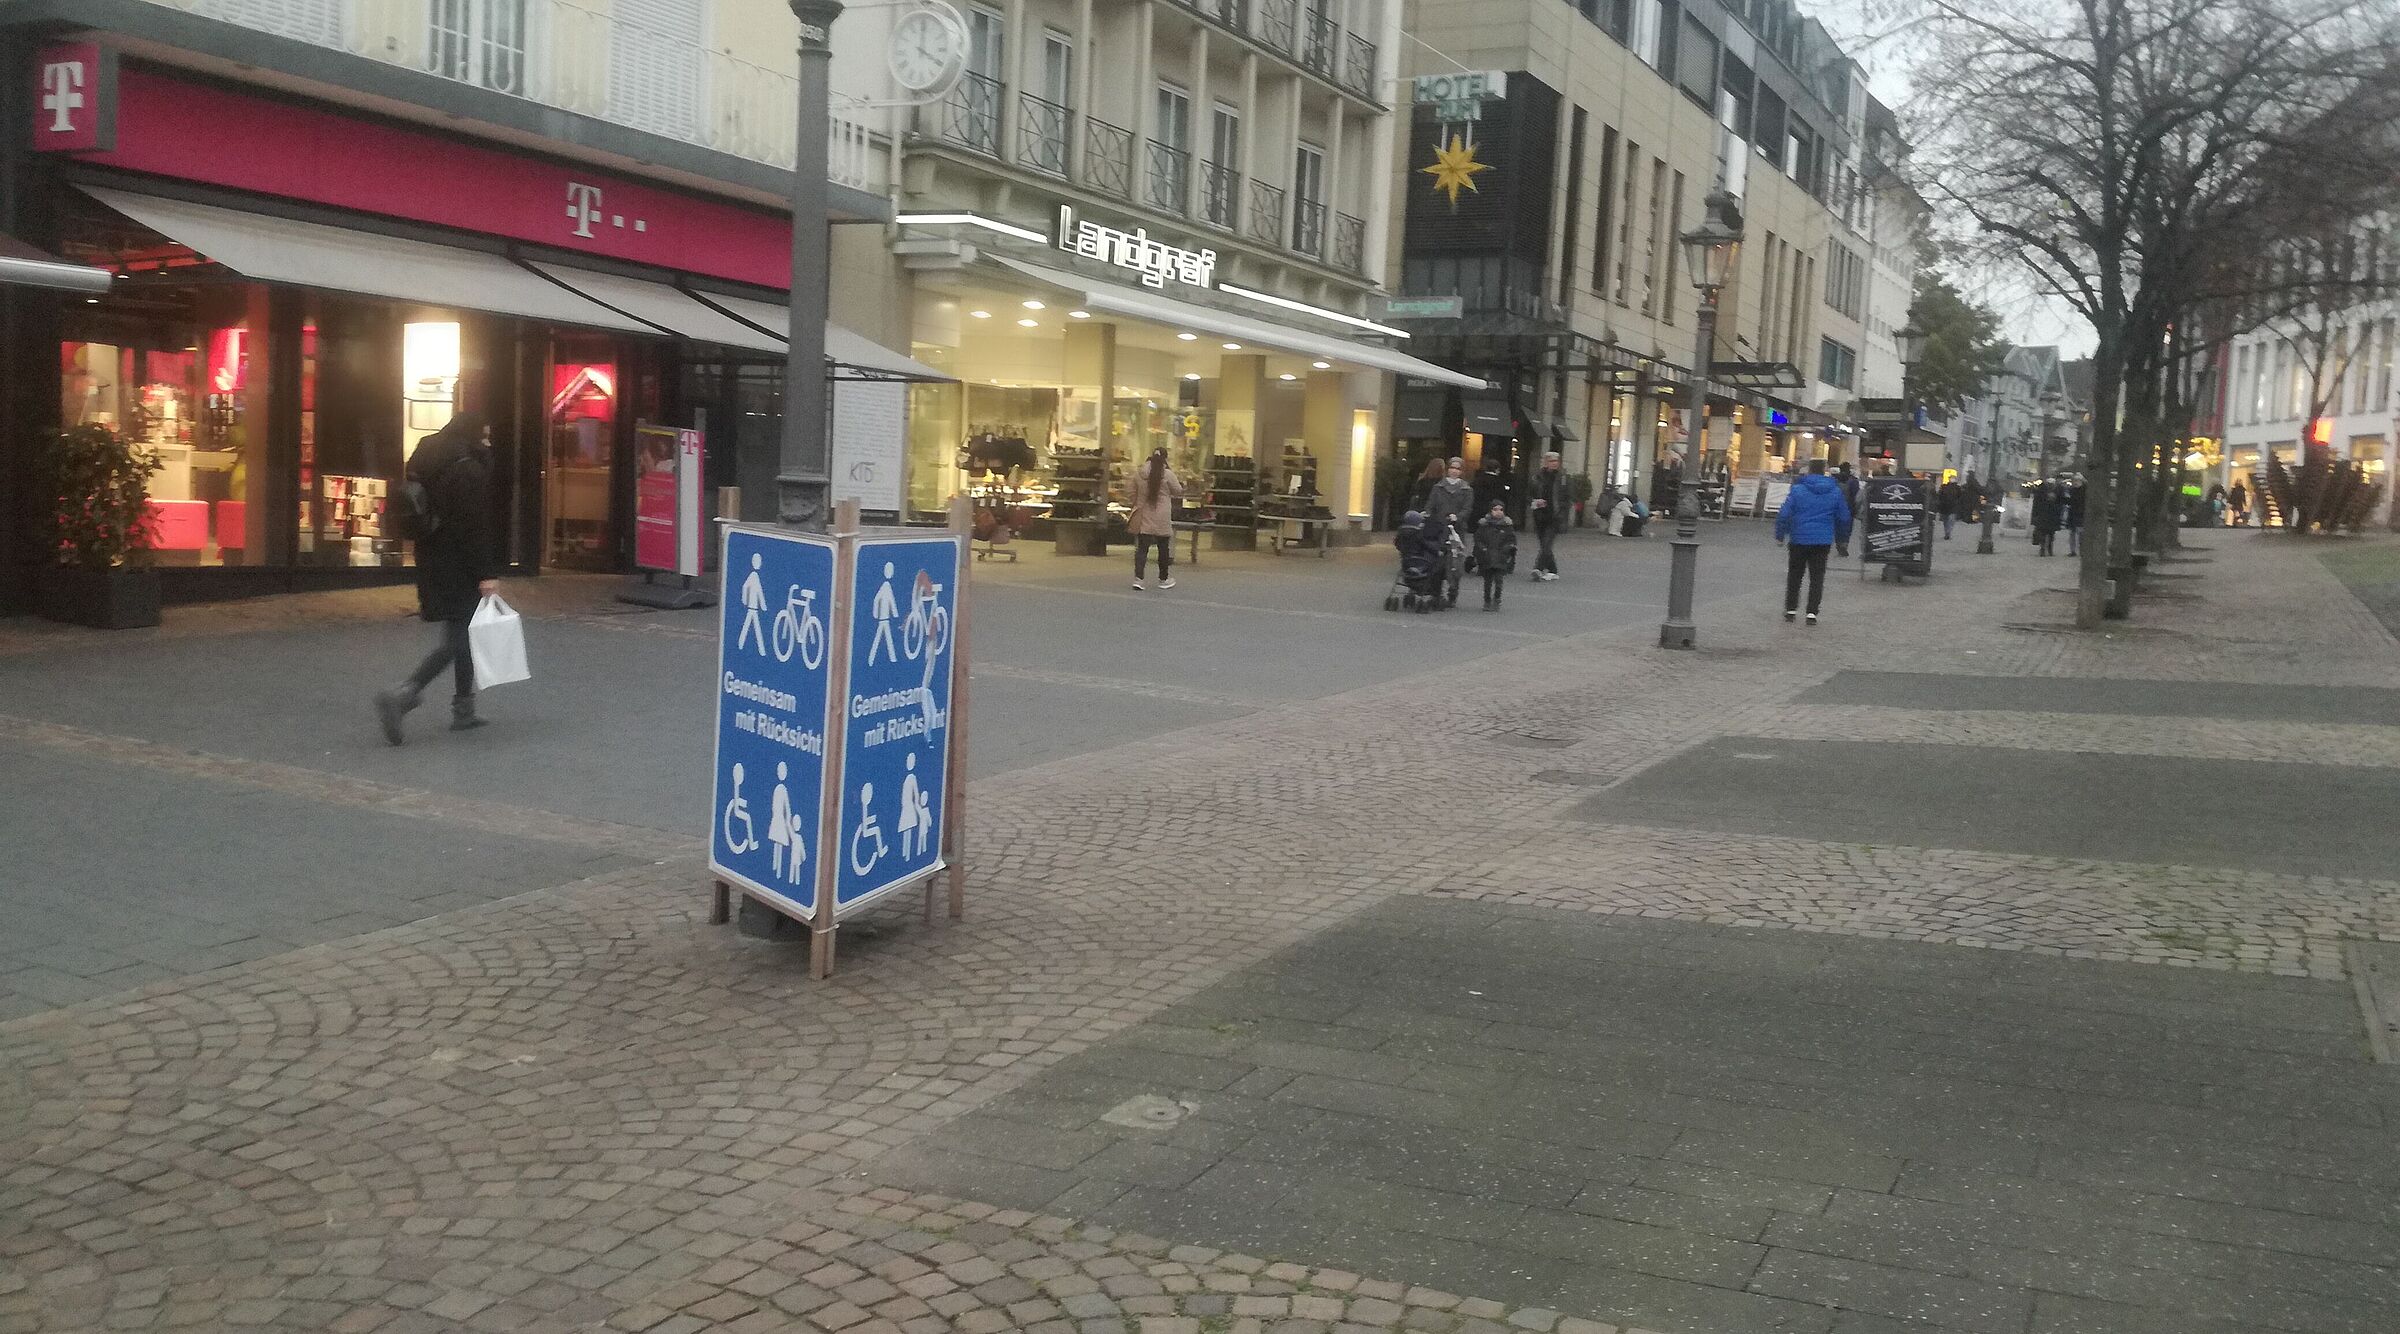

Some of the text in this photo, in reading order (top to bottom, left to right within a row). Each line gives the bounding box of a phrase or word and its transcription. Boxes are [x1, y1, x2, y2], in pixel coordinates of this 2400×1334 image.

[43, 61, 83, 132] T
[1416, 73, 1495, 101] HOTEL
[1059, 204, 1217, 288] Landgraf
[724, 671, 796, 713] Gemeinsam
[735, 709, 822, 756] mit Rücksicht
[864, 707, 946, 748] mit Rücksht
